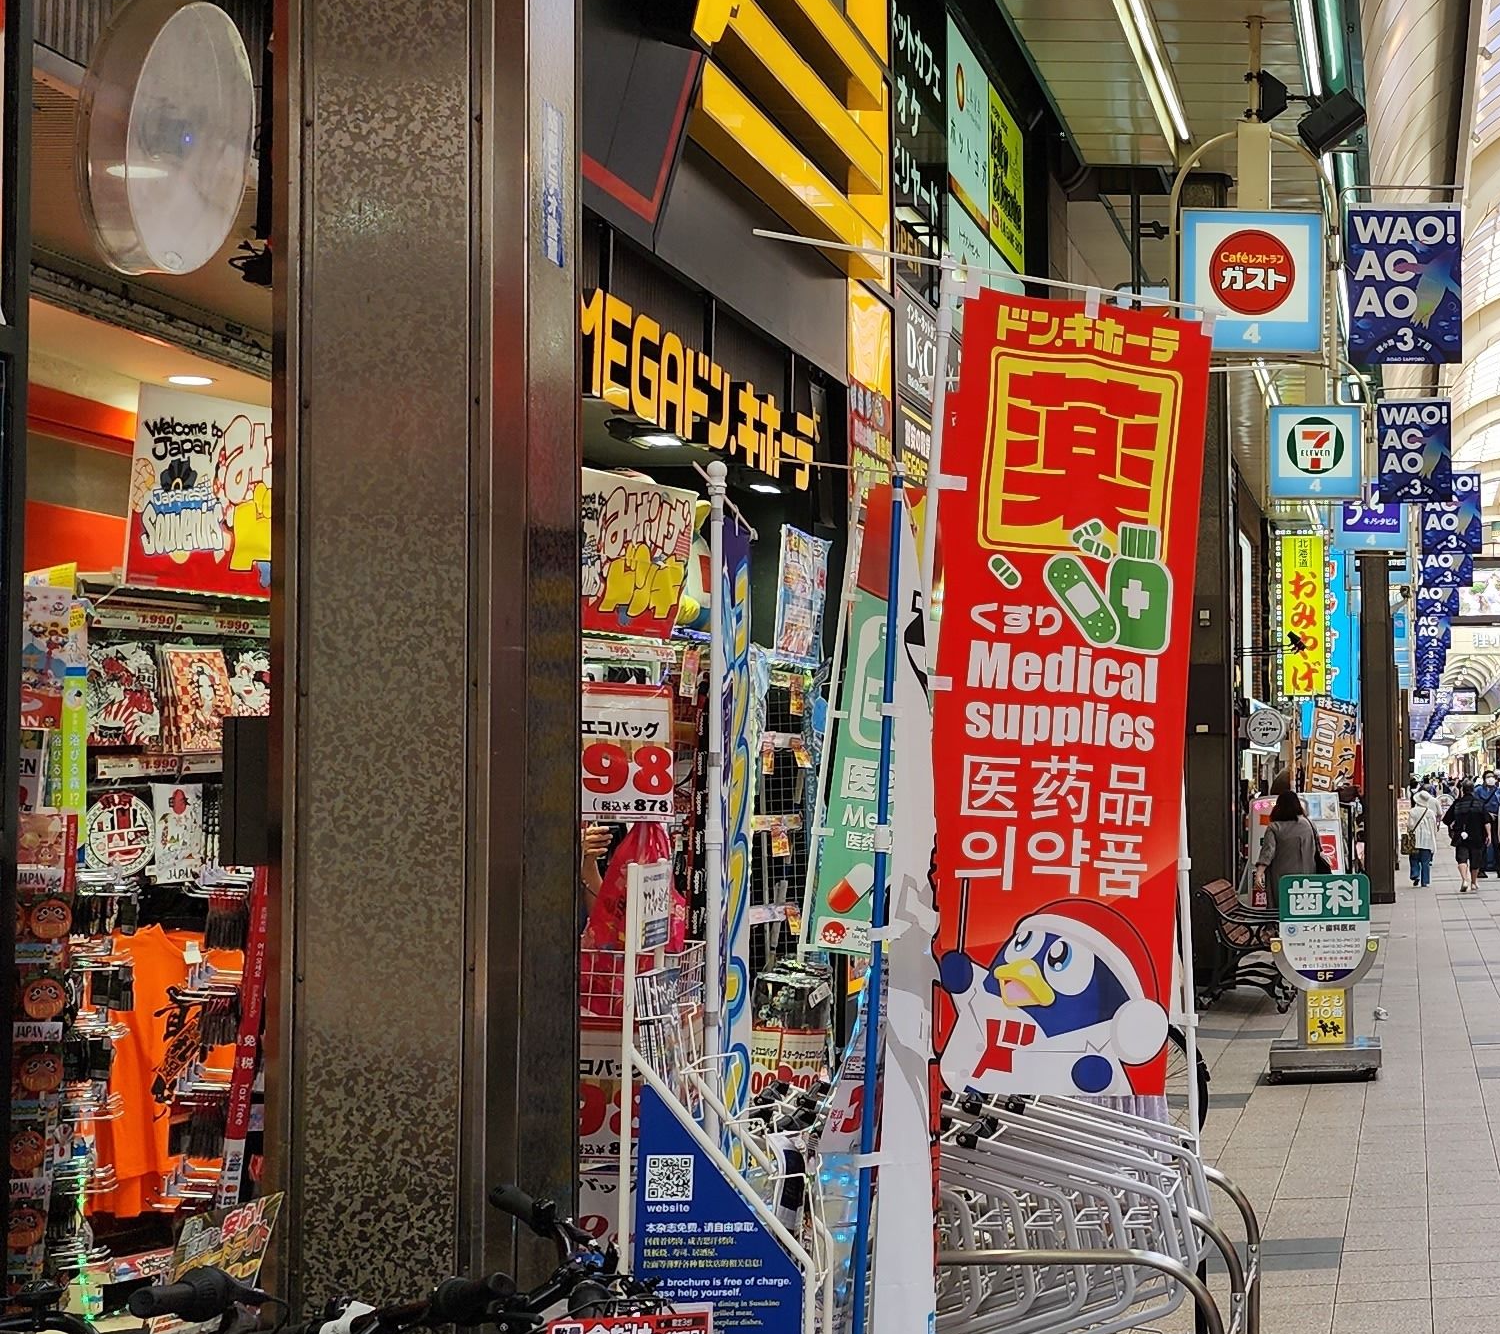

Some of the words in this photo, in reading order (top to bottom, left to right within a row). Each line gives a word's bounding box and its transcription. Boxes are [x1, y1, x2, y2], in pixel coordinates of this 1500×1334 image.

[1353, 216, 1456, 245] WAO!
[1221, 267, 1288, 291] ガスト
[1353, 285, 1418, 319] AO
[1243, 323, 1261, 344] 4
[1396, 327, 1415, 352] 3
[1380, 405, 1448, 425] WAO!
[144, 417, 208, 438] Welcome
[211, 420, 224, 438] to
[152, 434, 219, 464] Japan!
[1382, 452, 1424, 474] AO
[153, 486, 209, 505] Japanese
[1308, 478, 1322, 492] 4
[1410, 479, 1422, 495] 3
[140, 500, 225, 556] Souvenirs
[1366, 534, 1376, 545] 4
[969, 601, 1063, 636] くすり
[1288, 570, 1322, 693] おみやげ
[965, 640, 1159, 704] Medical
[582, 719, 660, 740] エコバッグ
[964, 700, 1155, 751] supplies
[1312, 712, 1339, 773] KOBE
[960, 755, 1154, 827] 医药品
[954, 825, 1148, 899] 의약품
[17, 871, 46, 886] JAPAN
[1288, 878, 1363, 915] 歯科
[1302, 924, 1357, 932] エイト歯科医院
[1316, 971, 1334, 980] 5F
[1308, 995, 1343, 1007] こども
[15, 1024, 44, 1039] JAPAN
[646, 1203, 690, 1214] website
[667, 1277, 711, 1287] brochure
[712, 1276, 722, 1287] is
[723, 1276, 744, 1287] free
[745, 1276, 755, 1287] of
[756, 1276, 792, 1288] charge.
[677, 1288, 699, 1299] help
[700, 1287, 742, 1299] yourself.
[718, 1299, 740, 1308] dining
[748, 1298, 780, 1308] Susukino
